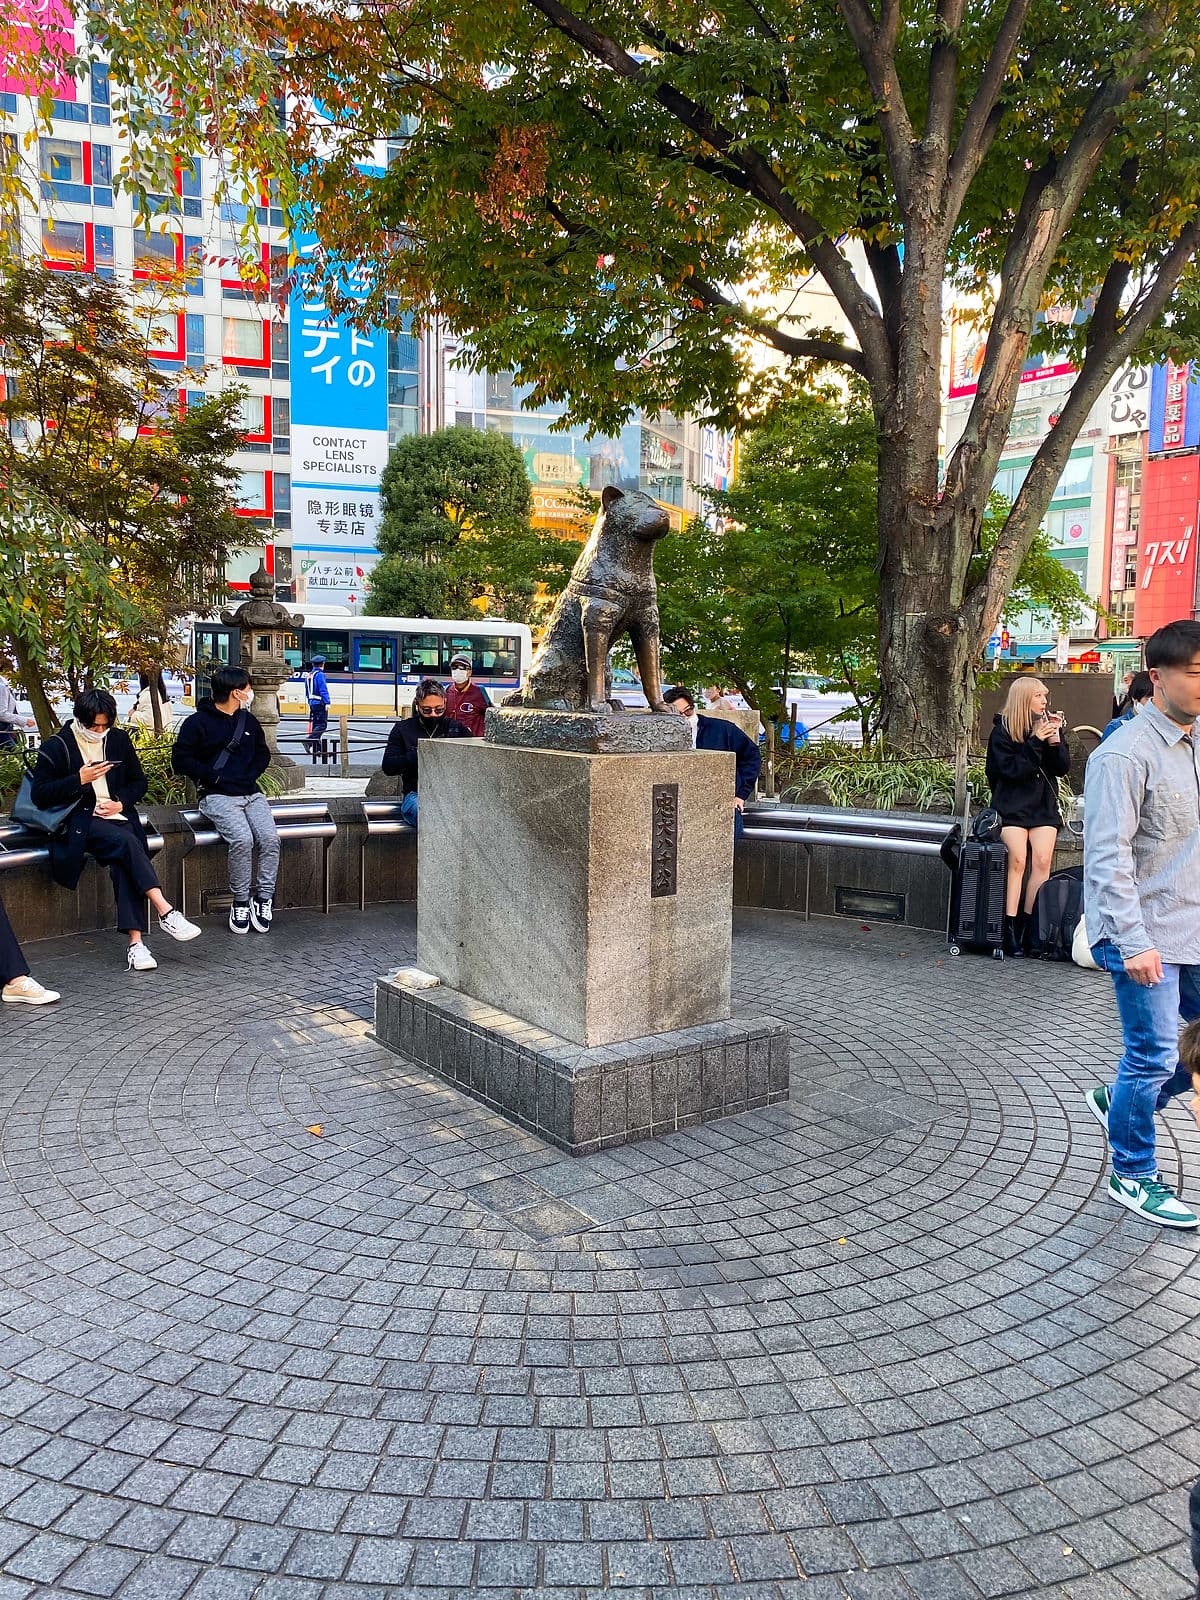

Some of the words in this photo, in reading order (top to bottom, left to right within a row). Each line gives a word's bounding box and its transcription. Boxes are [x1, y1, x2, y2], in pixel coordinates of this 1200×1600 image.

[312, 436, 367, 449] CONTACT
[325, 450, 354, 461] LENS
[303, 460, 377, 475] SPECIALISTS
[307, 499, 374, 518] 隐形眼镜
[316, 518, 366, 536] 专卖店
[1141, 525, 1194, 589] クスリ
[301, 561, 312, 569] 6F
[312, 566, 354, 577] ハチ公前
[308, 576, 357, 587] 献血ルーム
